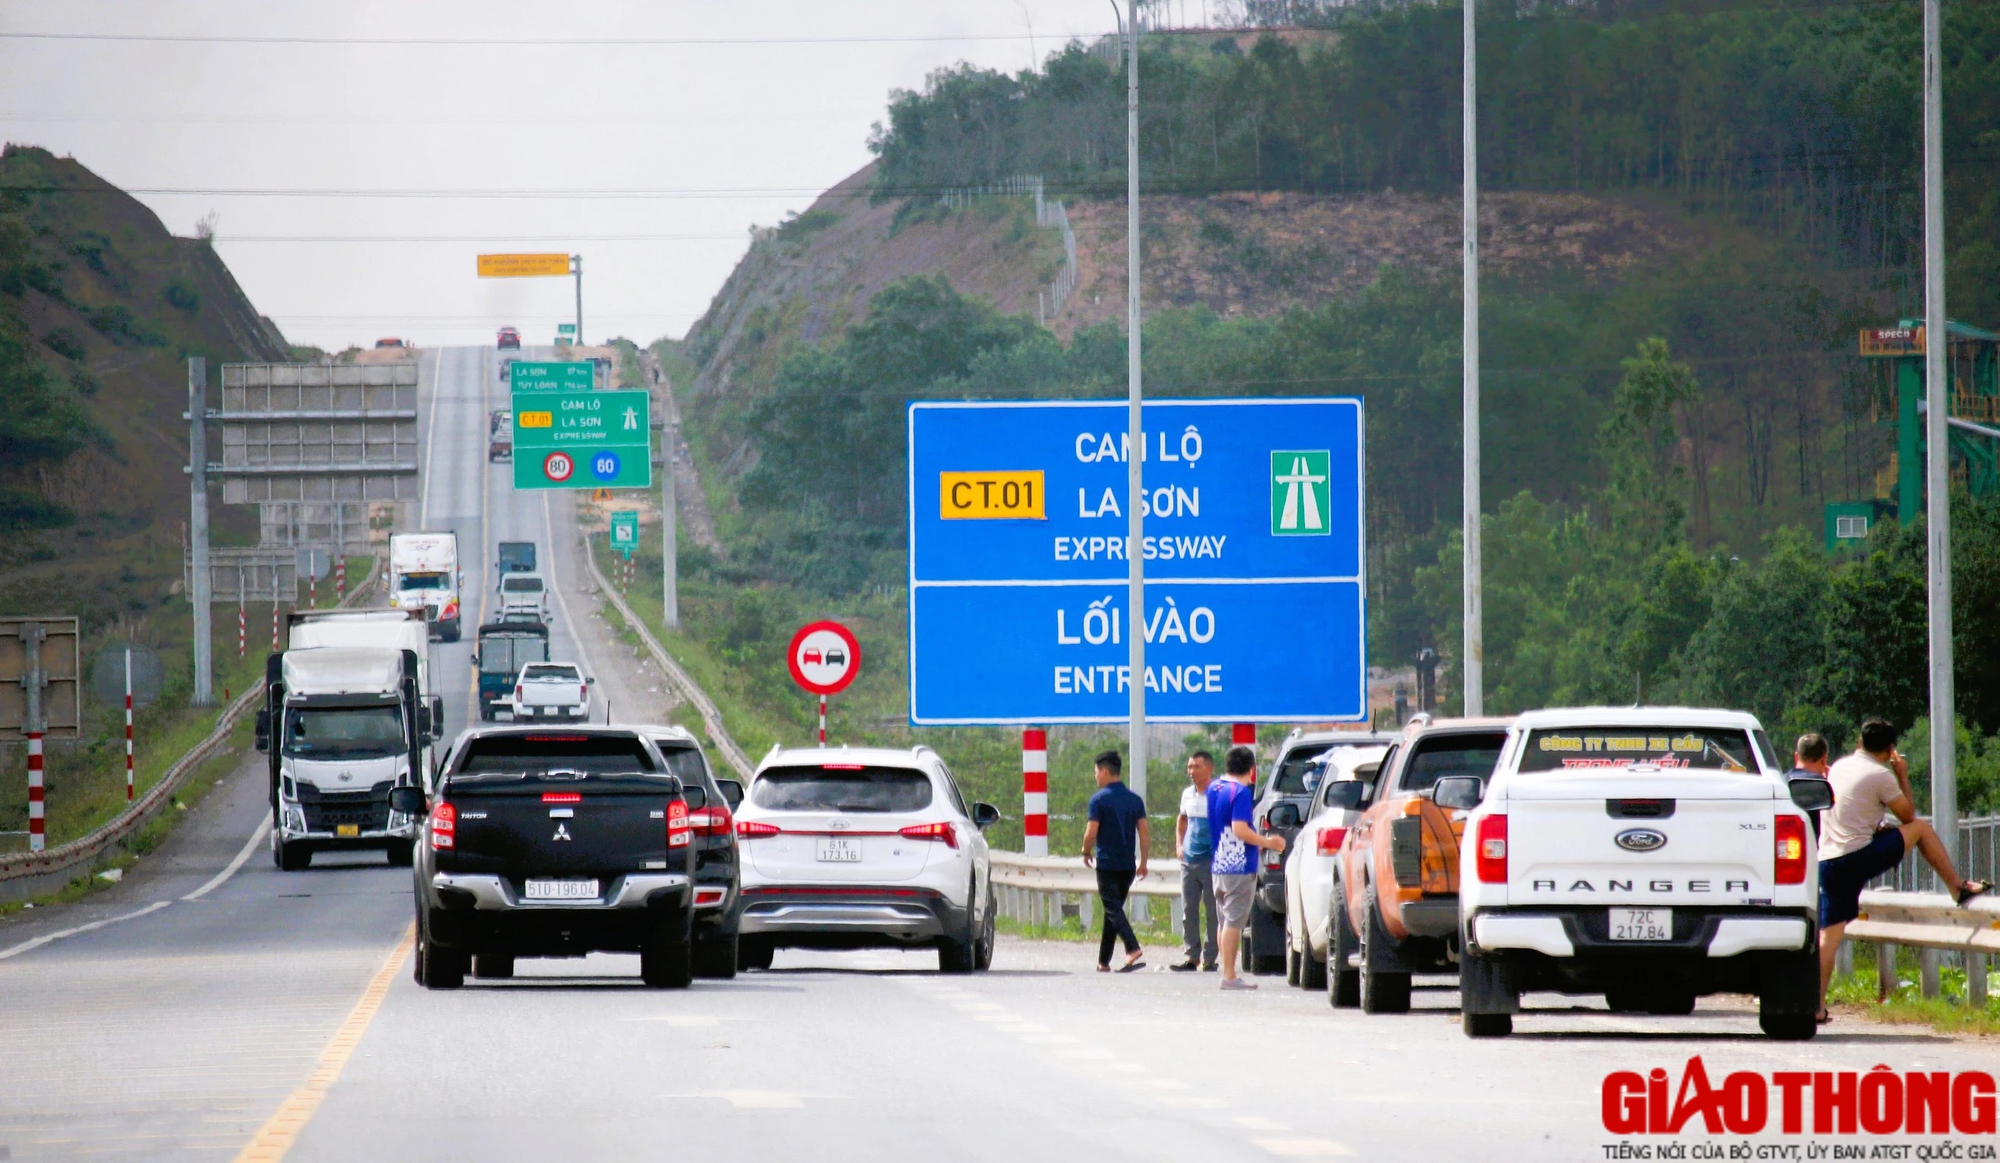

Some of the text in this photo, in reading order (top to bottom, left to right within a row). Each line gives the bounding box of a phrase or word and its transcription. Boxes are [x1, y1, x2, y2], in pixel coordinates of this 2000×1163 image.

[516, 368, 528, 377] LA
[561, 400, 585, 411] CAM
[561, 418, 576, 427] LA
[553, 431, 607, 440] EXPRESSWAY
[1159, 425, 1202, 468] LỘ
[549, 459, 566, 473] 80
[597, 459, 615, 473] 60
[951, 480, 1034, 509] CT.01
[1079, 487, 1122, 518] LA
[1054, 535, 1227, 561] EXPRSSWAY
[1057, 595, 1216, 645] LỐI VÀO
[1054, 664, 1223, 694] ENTRANCE
[1540, 735, 1582, 751] CÔNG
[1584, 737, 1603, 750] TY
[1605, 737, 1646, 751] TNHH
[1648, 738, 1669, 751] XE
[1739, 823, 1767, 831] XLS
[1628, 832, 1653, 846] Ford
[822, 850, 857, 860] 173.16
[1533, 880, 1749, 892] RANGER
[1627, 911, 1654, 924] 72C
[1616, 926, 1665, 939] 217.84
